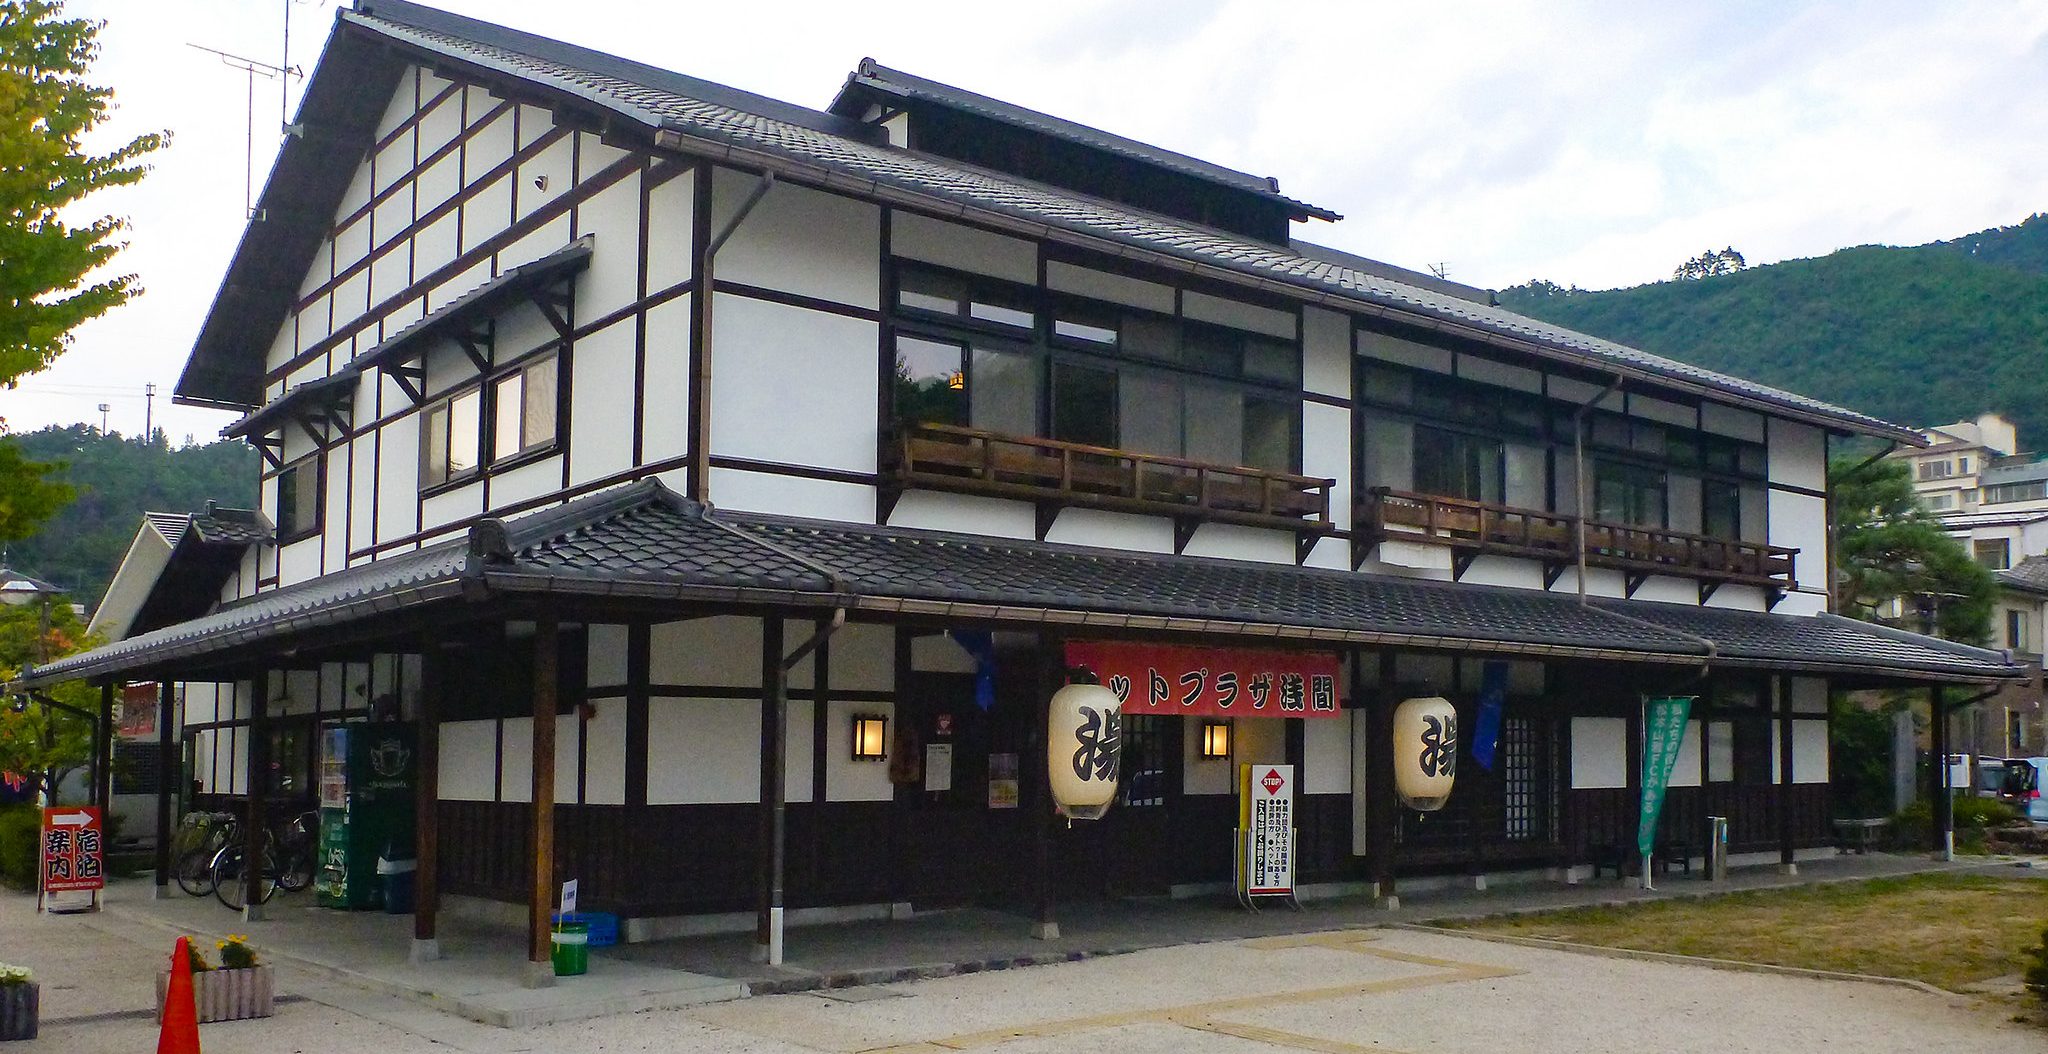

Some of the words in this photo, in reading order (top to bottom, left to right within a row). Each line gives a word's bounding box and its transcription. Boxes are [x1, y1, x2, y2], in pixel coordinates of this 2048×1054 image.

[1263, 777, 1282, 786] STOP!
[46, 828, 72, 881] 案内
[76, 827, 102, 879] 宿泊
